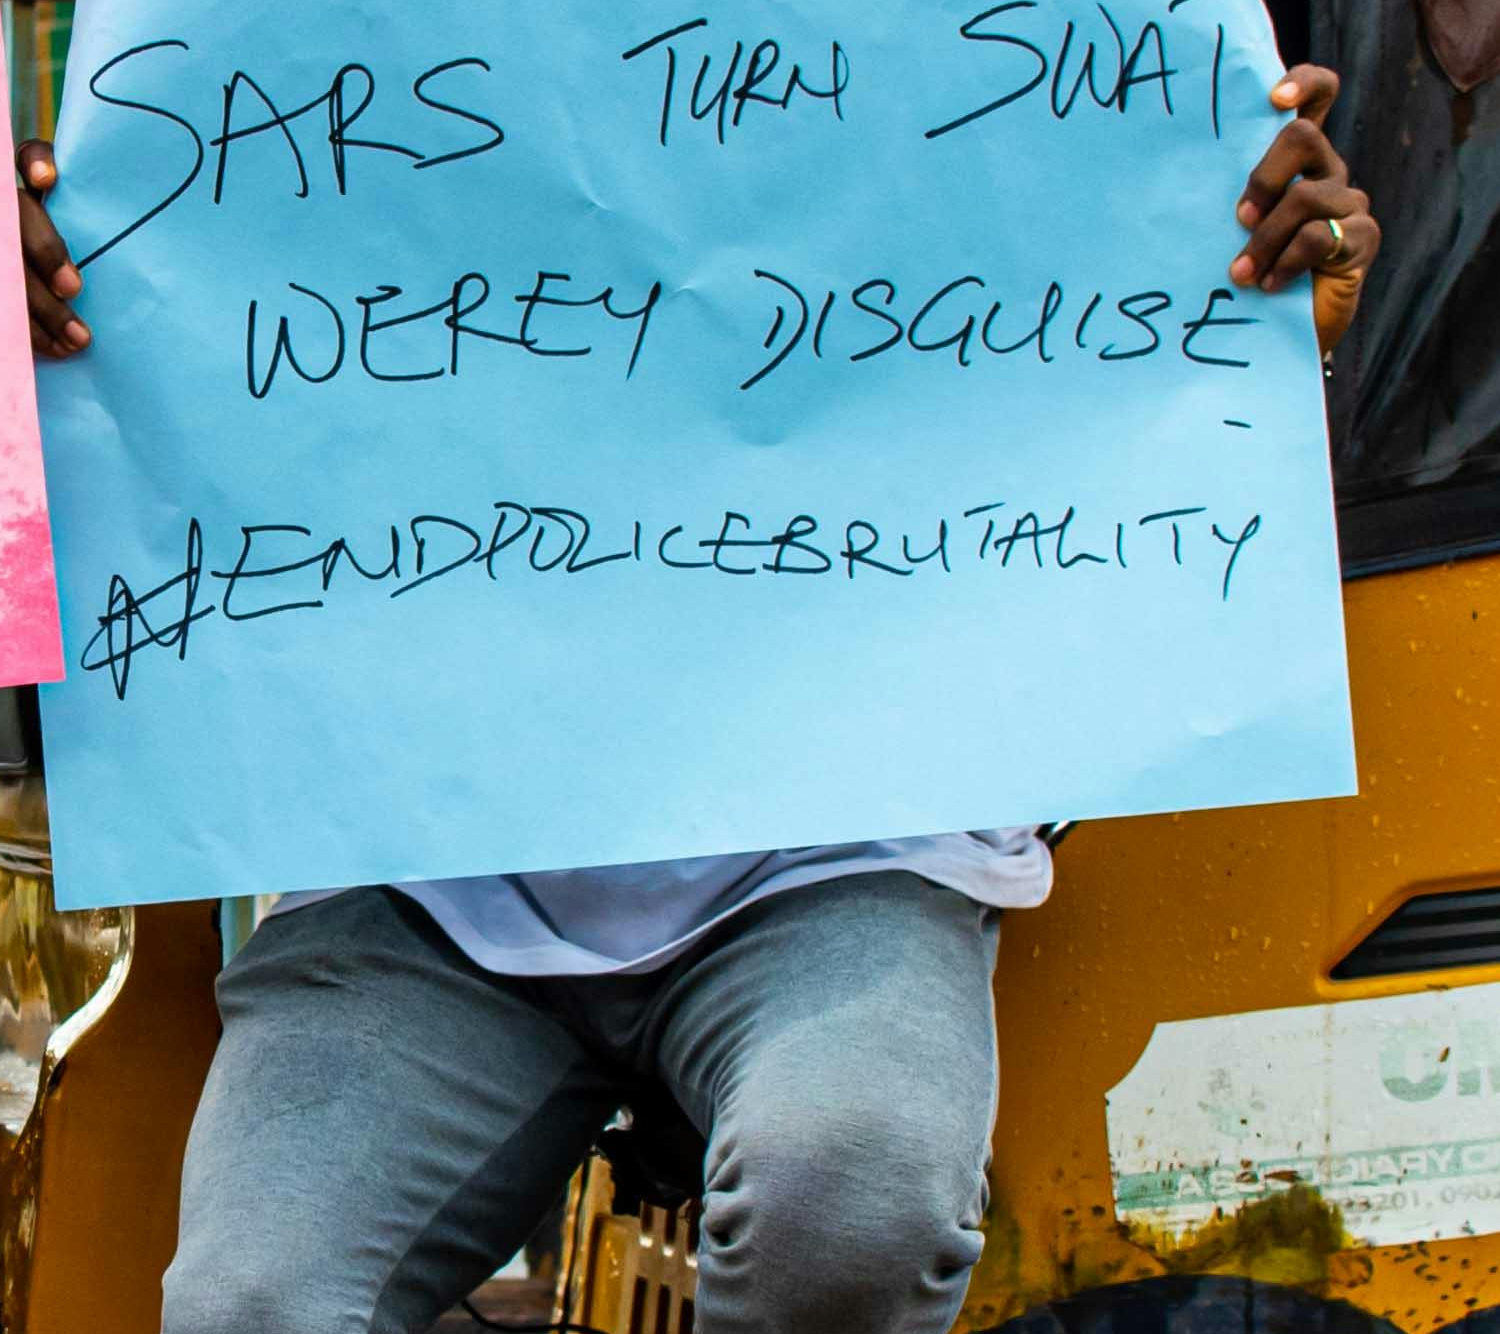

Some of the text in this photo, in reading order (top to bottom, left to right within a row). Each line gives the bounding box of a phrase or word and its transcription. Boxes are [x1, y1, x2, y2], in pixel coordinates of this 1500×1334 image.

[76, 40, 504, 271] SARS
[622, 18, 848, 146] TURN
[247, 269, 1252, 399] WEREY DISGUISE
[81, 502, 1259, 701] #ENDPOLICEBRUTALITY
